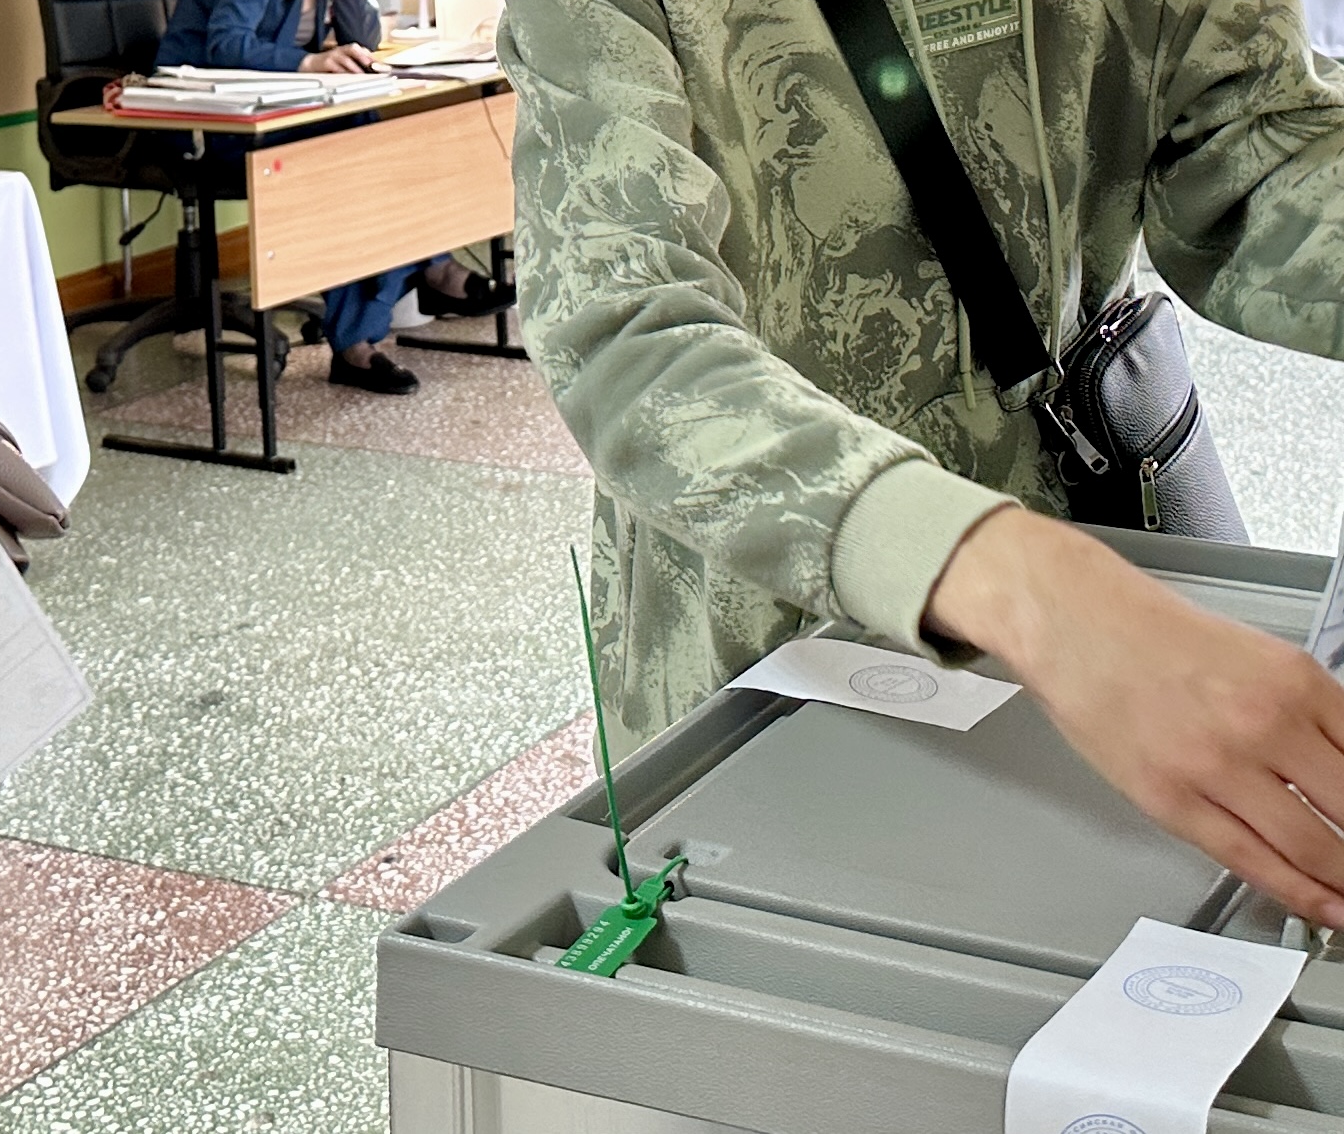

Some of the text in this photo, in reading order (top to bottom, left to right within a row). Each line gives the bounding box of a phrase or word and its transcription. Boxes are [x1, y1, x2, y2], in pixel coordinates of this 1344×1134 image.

[952, 34, 974, 48] AND
[976, 24, 1009, 41] ENJOY
[1009, 21, 1020, 33] IT
